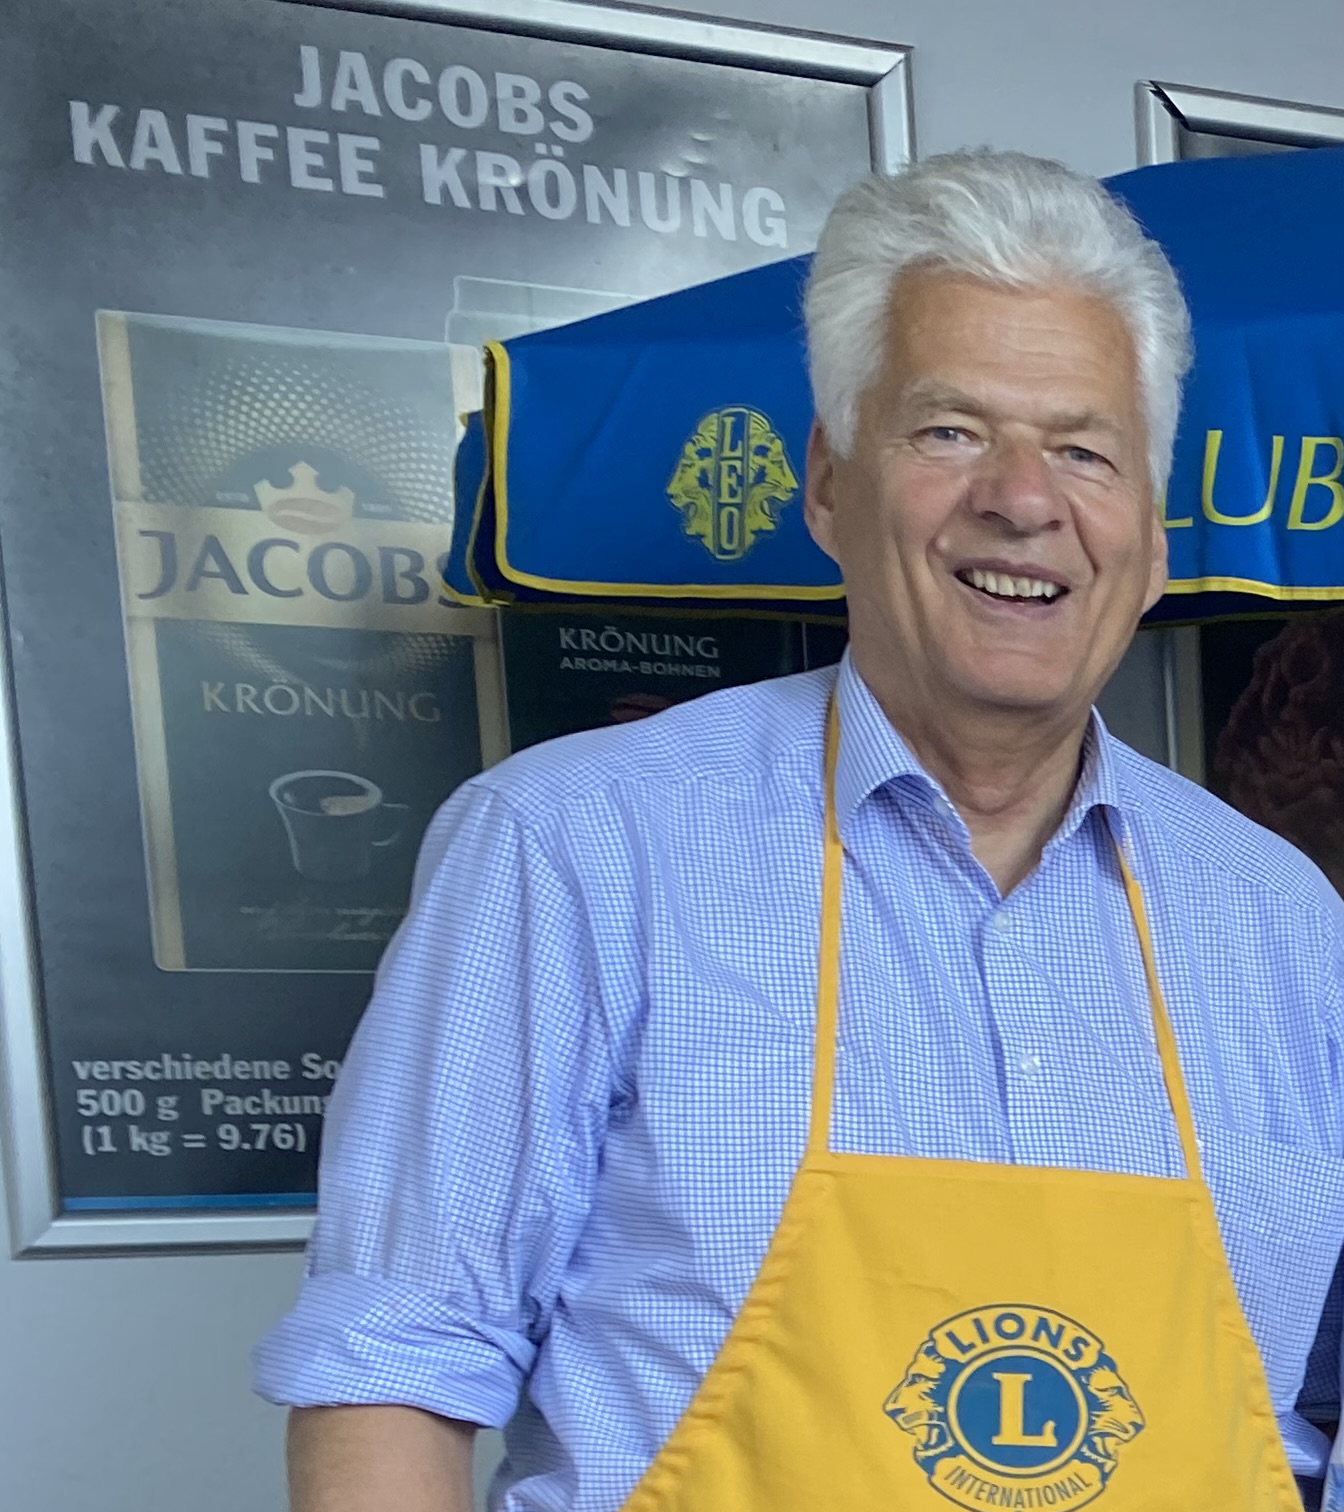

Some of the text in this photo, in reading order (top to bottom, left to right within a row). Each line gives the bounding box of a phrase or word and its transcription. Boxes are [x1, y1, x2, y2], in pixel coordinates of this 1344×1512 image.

[292, 45, 595, 143] JACOBS
[68, 100, 788, 248] KAFFEE KRÖNUNG
[719, 416, 745, 550] LEO
[559, 626, 719, 658] KRÖNUNG
[559, 656, 721, 678] AROMA-BOHNEN
[201, 679, 442, 724] KRÖNUNG
[72, 1053, 291, 1081] verschiedene
[76, 1089, 146, 1116] 500
[156, 1095, 180, 1121] g
[82, 1124, 118, 1155] (1
[128, 1124, 172, 1156] kg
[216, 1123, 307, 1152] 9.76)
[945, 1312, 1090, 1362] LIONS
[991, 1372, 1057, 1447] L
[944, 1465, 1093, 1509] INTERNATIONAL
